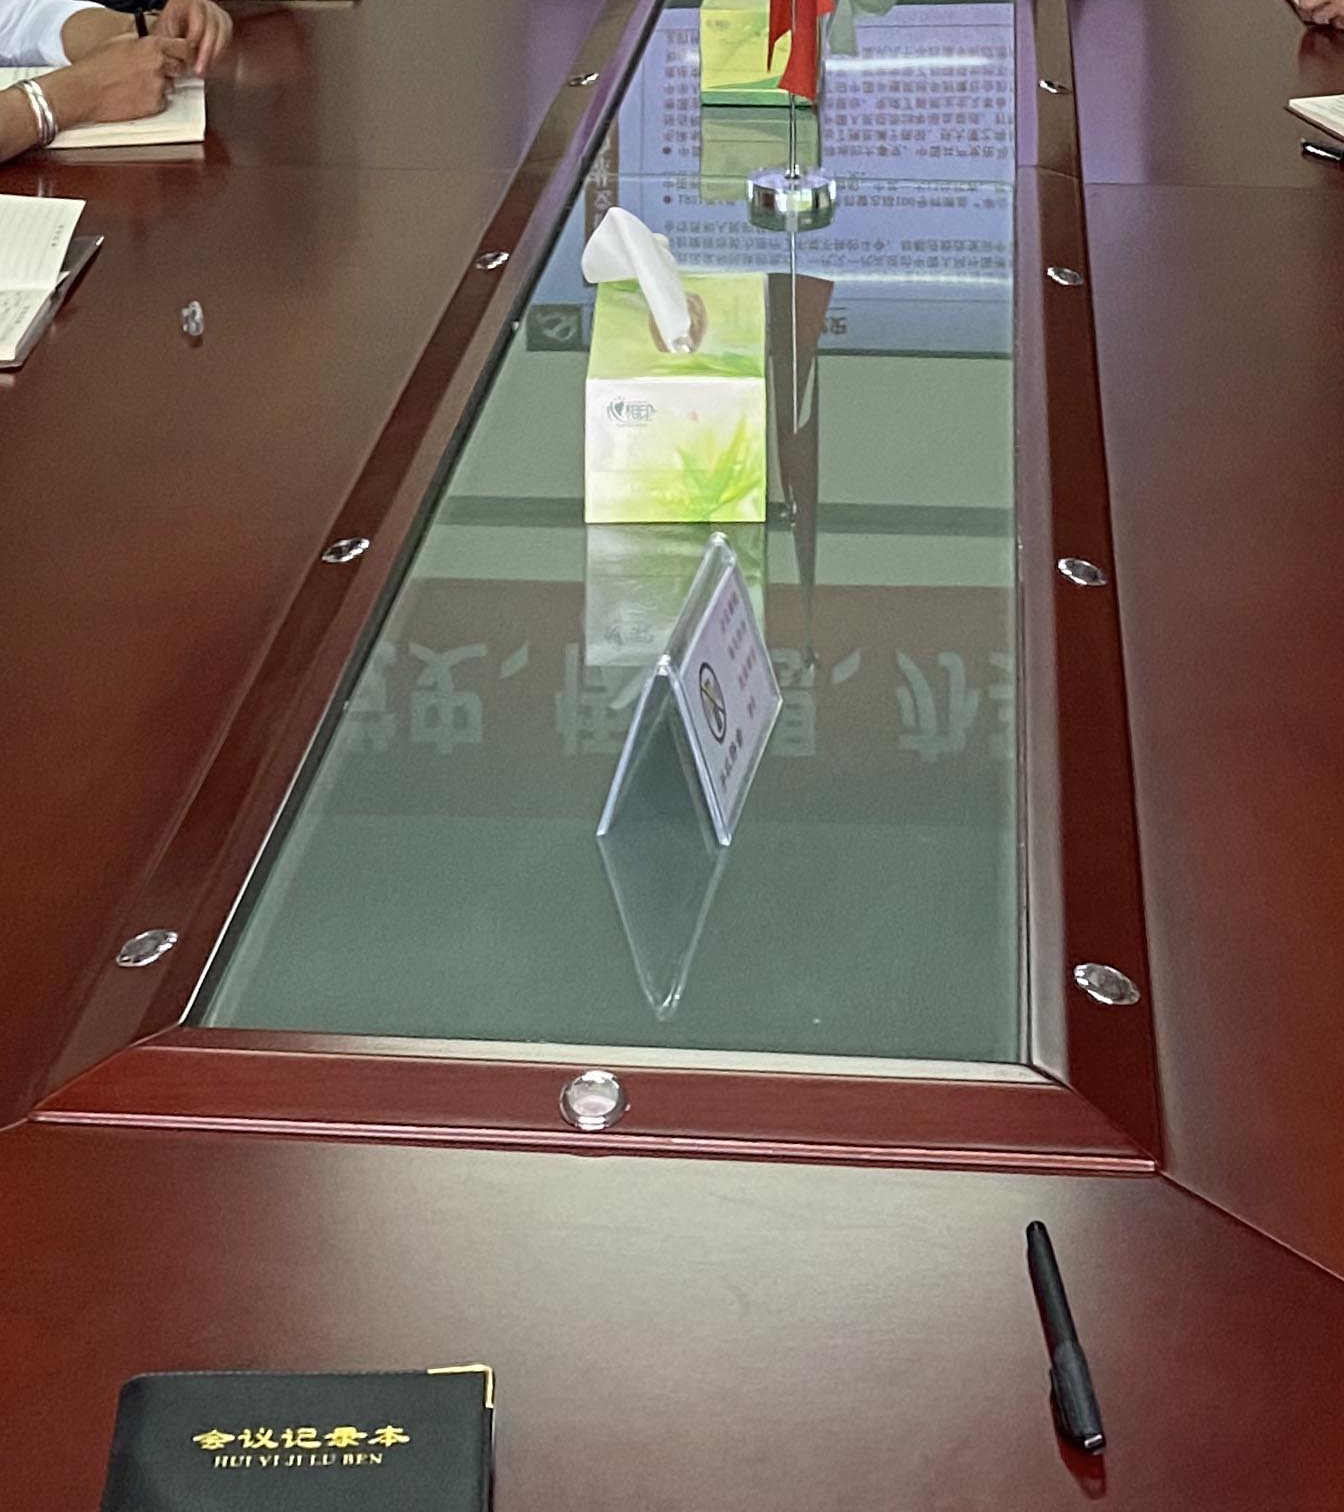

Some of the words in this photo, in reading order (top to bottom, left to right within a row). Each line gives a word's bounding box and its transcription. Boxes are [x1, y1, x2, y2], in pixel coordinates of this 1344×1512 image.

[192, 1425, 410, 1450] 会议记录本
[214, 1453, 253, 1469] HUI
[259, 1454, 280, 1468] YI
[284, 1453, 304, 1468] JI
